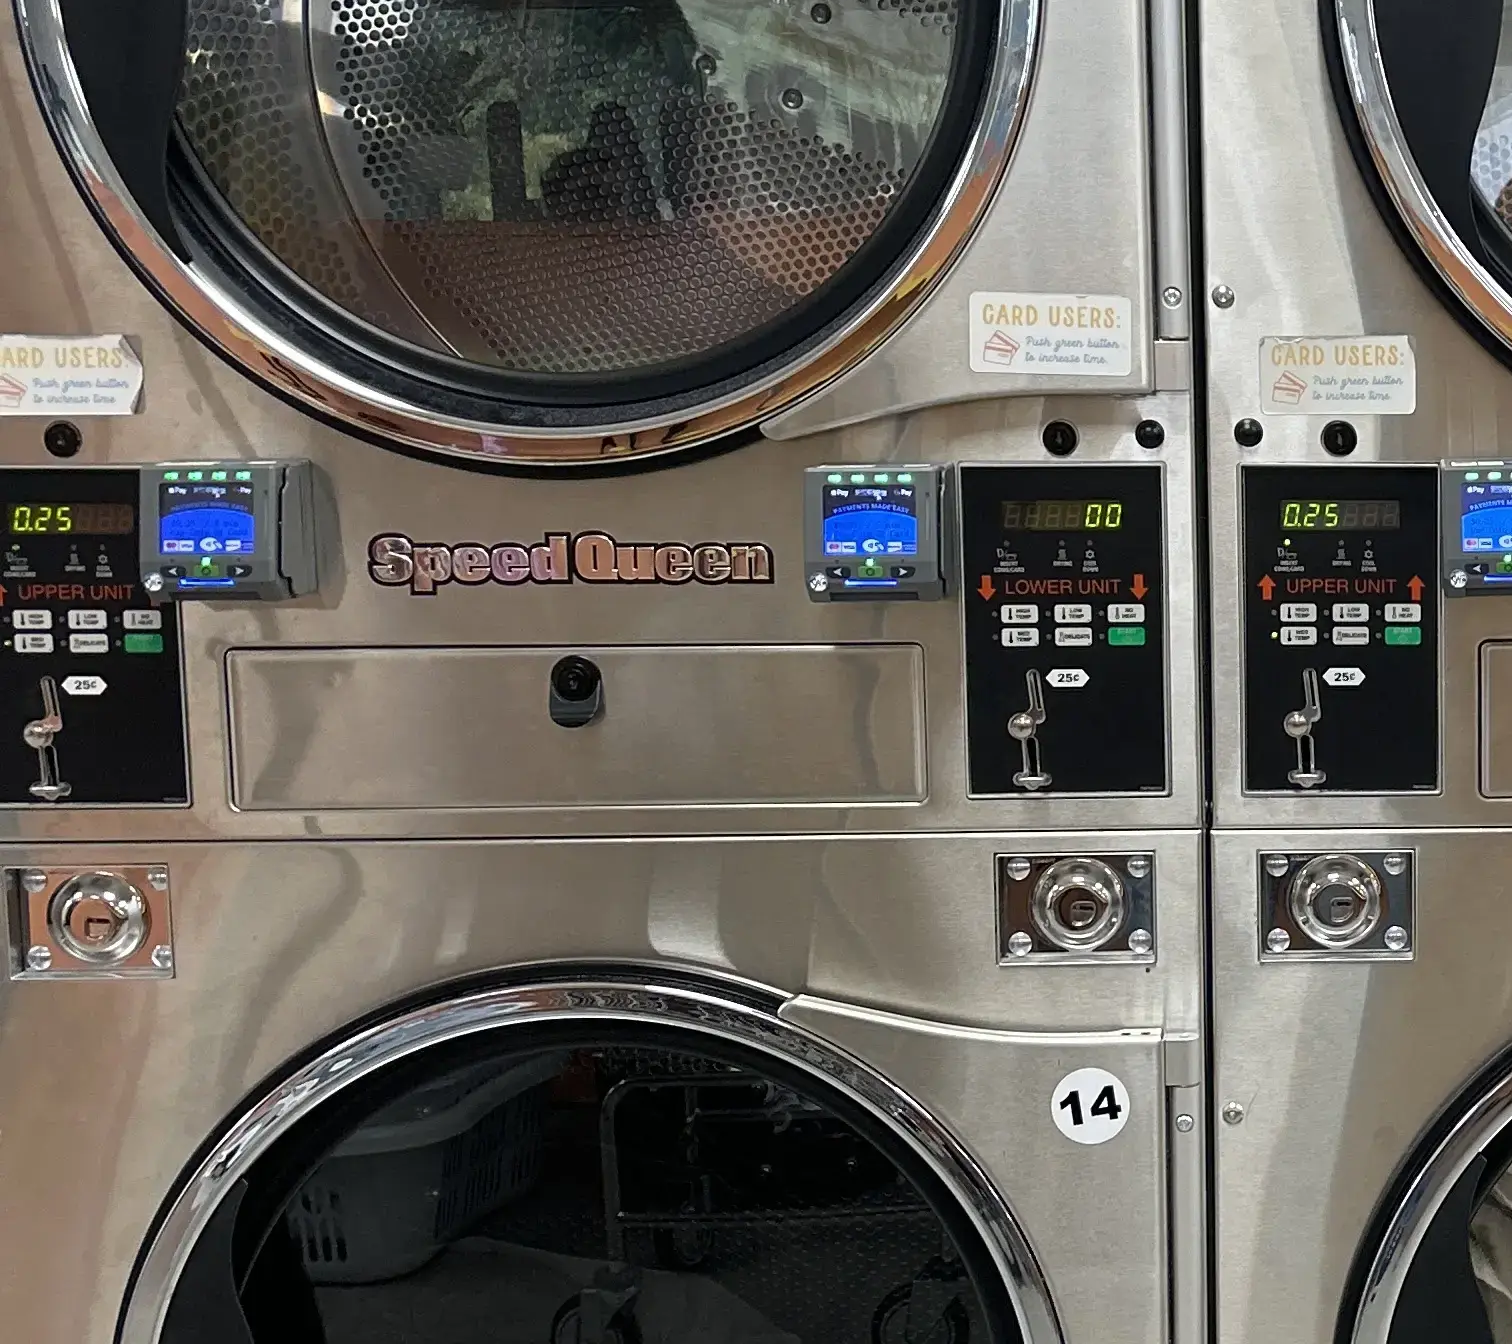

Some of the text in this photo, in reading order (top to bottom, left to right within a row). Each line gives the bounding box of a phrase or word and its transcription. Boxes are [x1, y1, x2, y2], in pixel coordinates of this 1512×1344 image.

[982, 304, 1121, 329] CARD USERS:
[1025, 335, 1120, 352] Push green button
[1025, 352, 1035, 362] to
[1038, 353, 1081, 363] increase
[1271, 344, 1404, 366] CARD USERS:
[1312, 375, 1403, 390] Push green button
[1312, 391, 1323, 400] to
[14, 507, 72, 532] 0.25
[1283, 504, 1339, 527] 0.25
[368, 531, 774, 596] Speed Queen
[18, 584, 135, 600] UPPER UNIT
[1005, 579, 1122, 595] LOWER UNIT
[1286, 579, 1397, 594] UPPER UNIT
[1334, 672, 1356, 682] 25¢
[1060, 1085, 1122, 1126] 14
